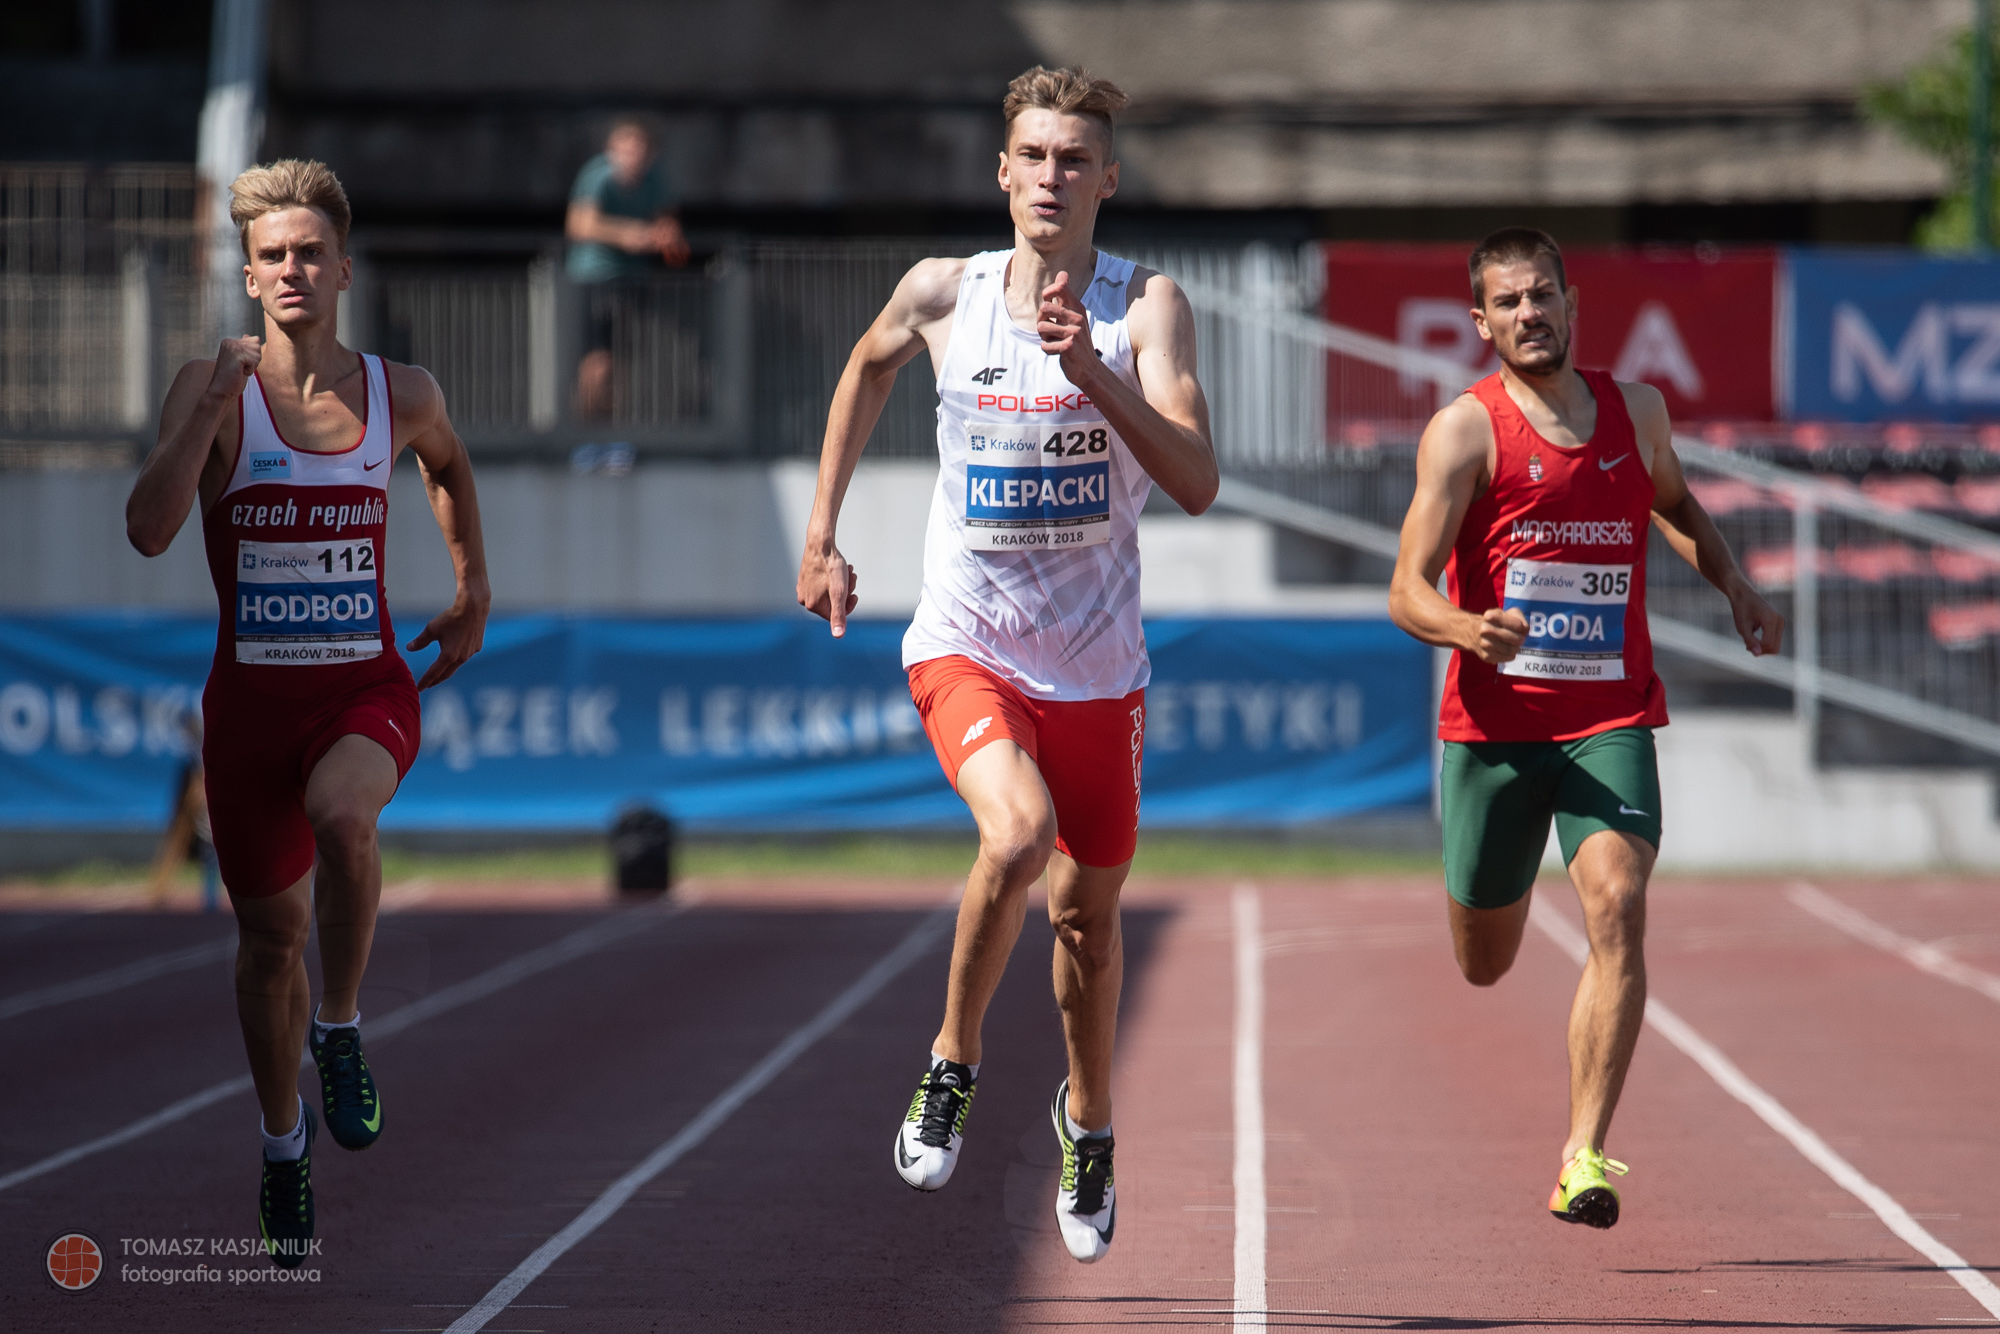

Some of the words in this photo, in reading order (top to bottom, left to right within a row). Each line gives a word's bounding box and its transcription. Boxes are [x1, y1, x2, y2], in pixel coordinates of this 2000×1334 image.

[1397, 298, 1702, 398] PA
[971, 367, 1008, 386] 4F
[990, 439, 1036, 451] Kraków
[1043, 428, 1108, 457] 428
[253, 458, 279, 468] ČESKÁ
[970, 474, 1105, 508] KLEPACKI
[231, 498, 298, 527] czech
[308, 497, 384, 532] republic
[992, 532, 1050, 546] KRAKÓW
[1054, 531, 1084, 544] 2018
[1510, 518, 1633, 545] MAGYARORSZÁG
[261, 556, 309, 568] Kraków
[317, 546, 375, 573] 112
[1530, 574, 1574, 588] Kraków
[1580, 572, 1629, 596] 305
[241, 592, 374, 622] HODBOD
[1528, 611, 1605, 641] BODA
[265, 646, 322, 660] KRAKÓW
[326, 647, 356, 659] 2018
[1524, 661, 1577, 675] KRAKÓW
[1579, 665, 1602, 676] 2018
[658, 684, 925, 755] LEKKIE
[1147, 680, 1362, 751] ETYKI
[961, 716, 993, 747] 4F
